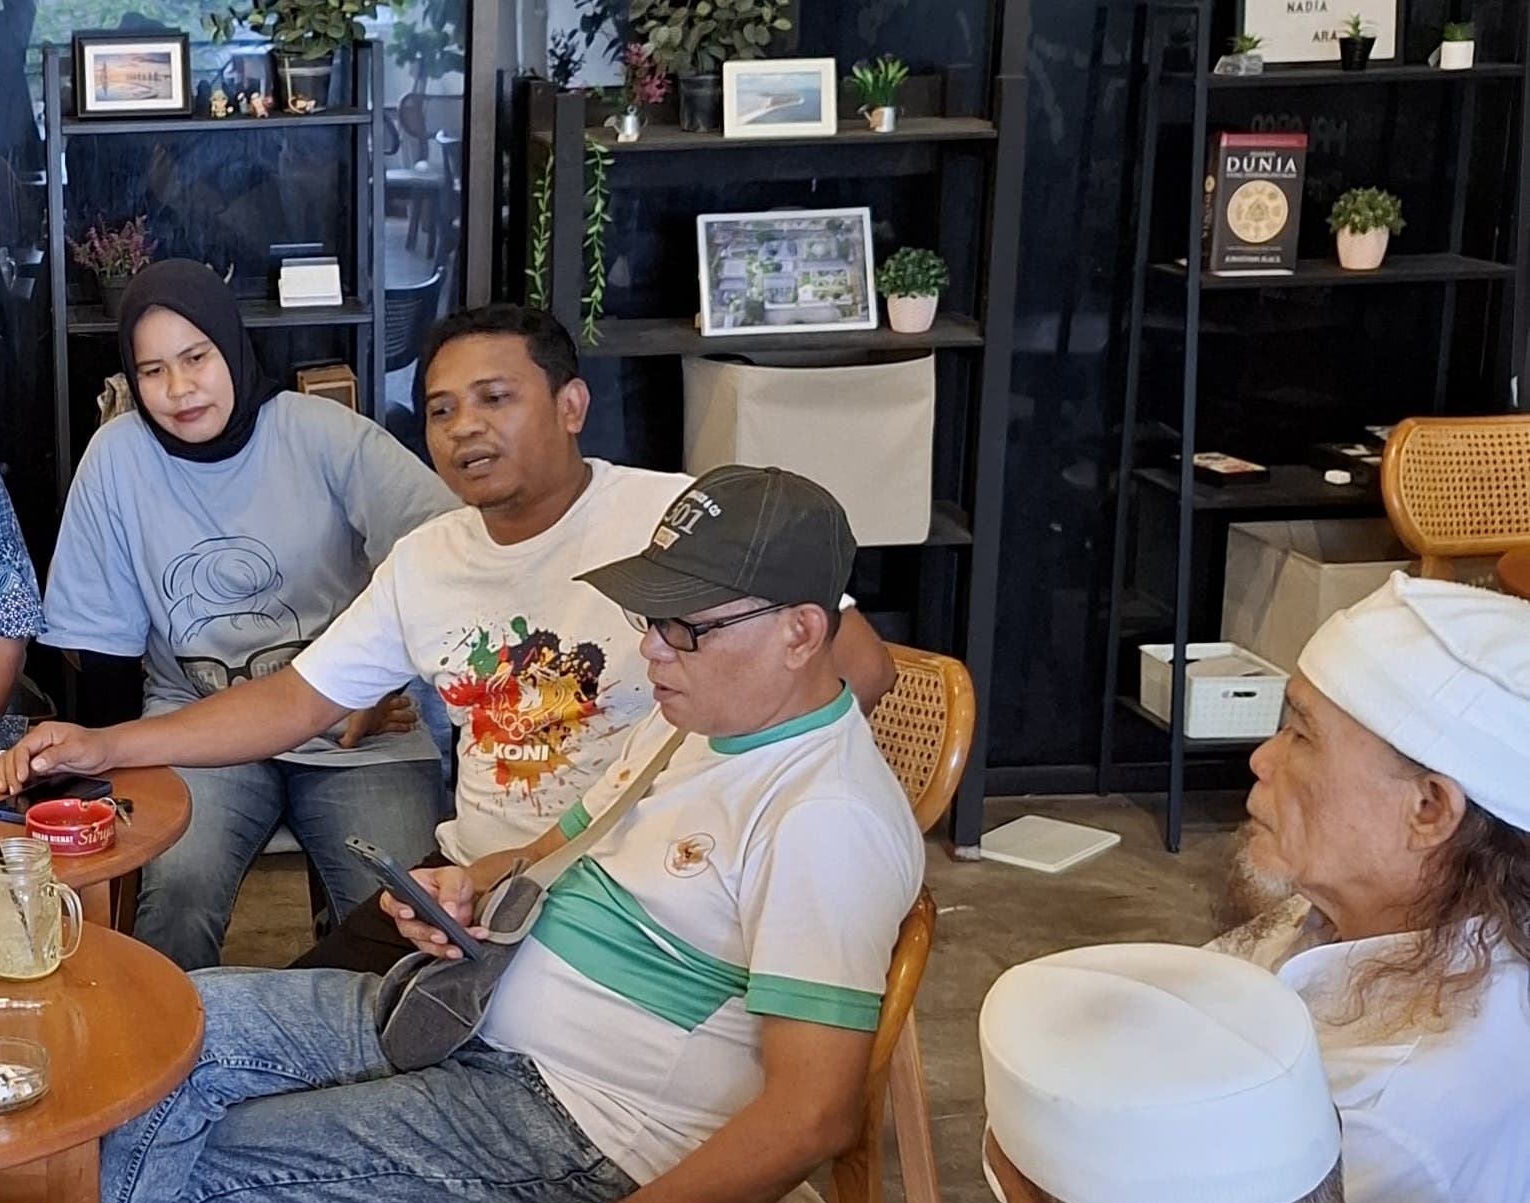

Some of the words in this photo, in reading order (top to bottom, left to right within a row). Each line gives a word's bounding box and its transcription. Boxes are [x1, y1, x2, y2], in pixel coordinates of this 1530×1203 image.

[1286, 0, 1327, 12] NADIA
[1226, 156, 1297, 173] DUNIA
[493, 741, 549, 761] KONI
